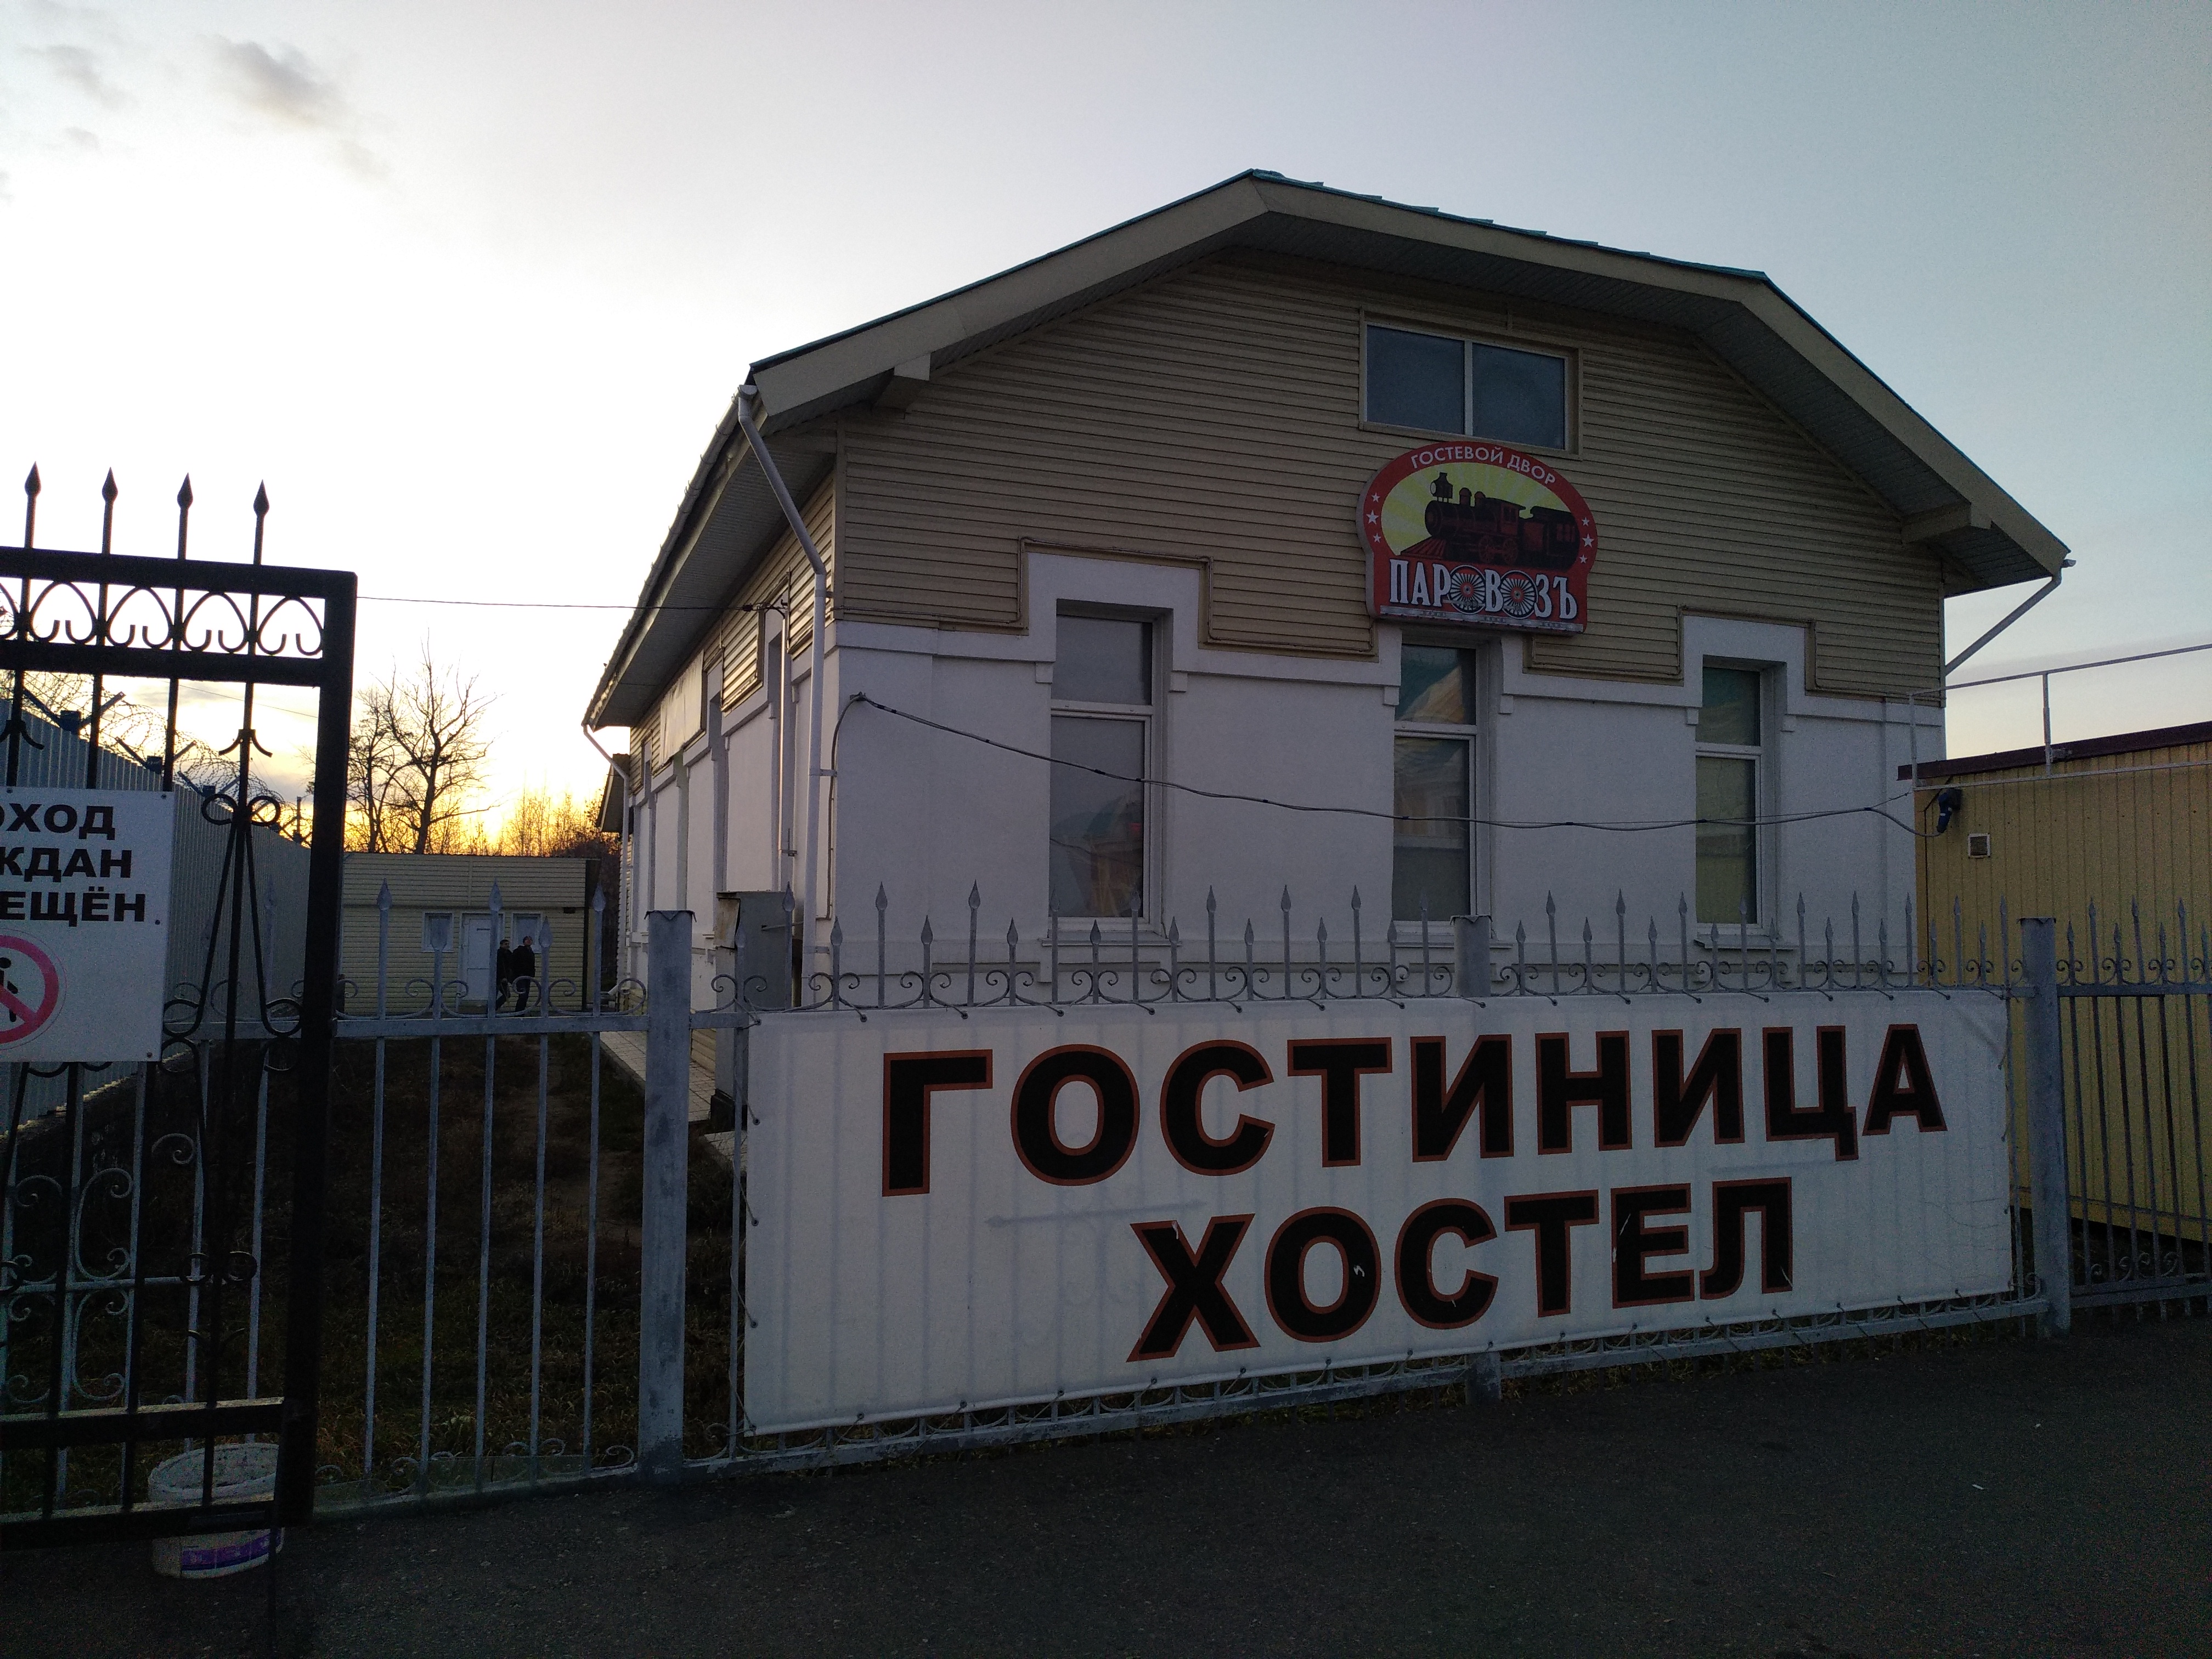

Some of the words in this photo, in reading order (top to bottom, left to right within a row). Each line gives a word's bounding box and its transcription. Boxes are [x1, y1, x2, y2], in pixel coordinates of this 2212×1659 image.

[1410, 445, 1504, 469] ГОСТЕВОЙ
[1507, 454, 1556, 486] ДВОР
[0, 803, 115, 840] ХОД
[881, 1023, 1948, 1198] ГОСТИНИЦА
[1126, 1175, 1794, 1363] ХОСТЕЛ
